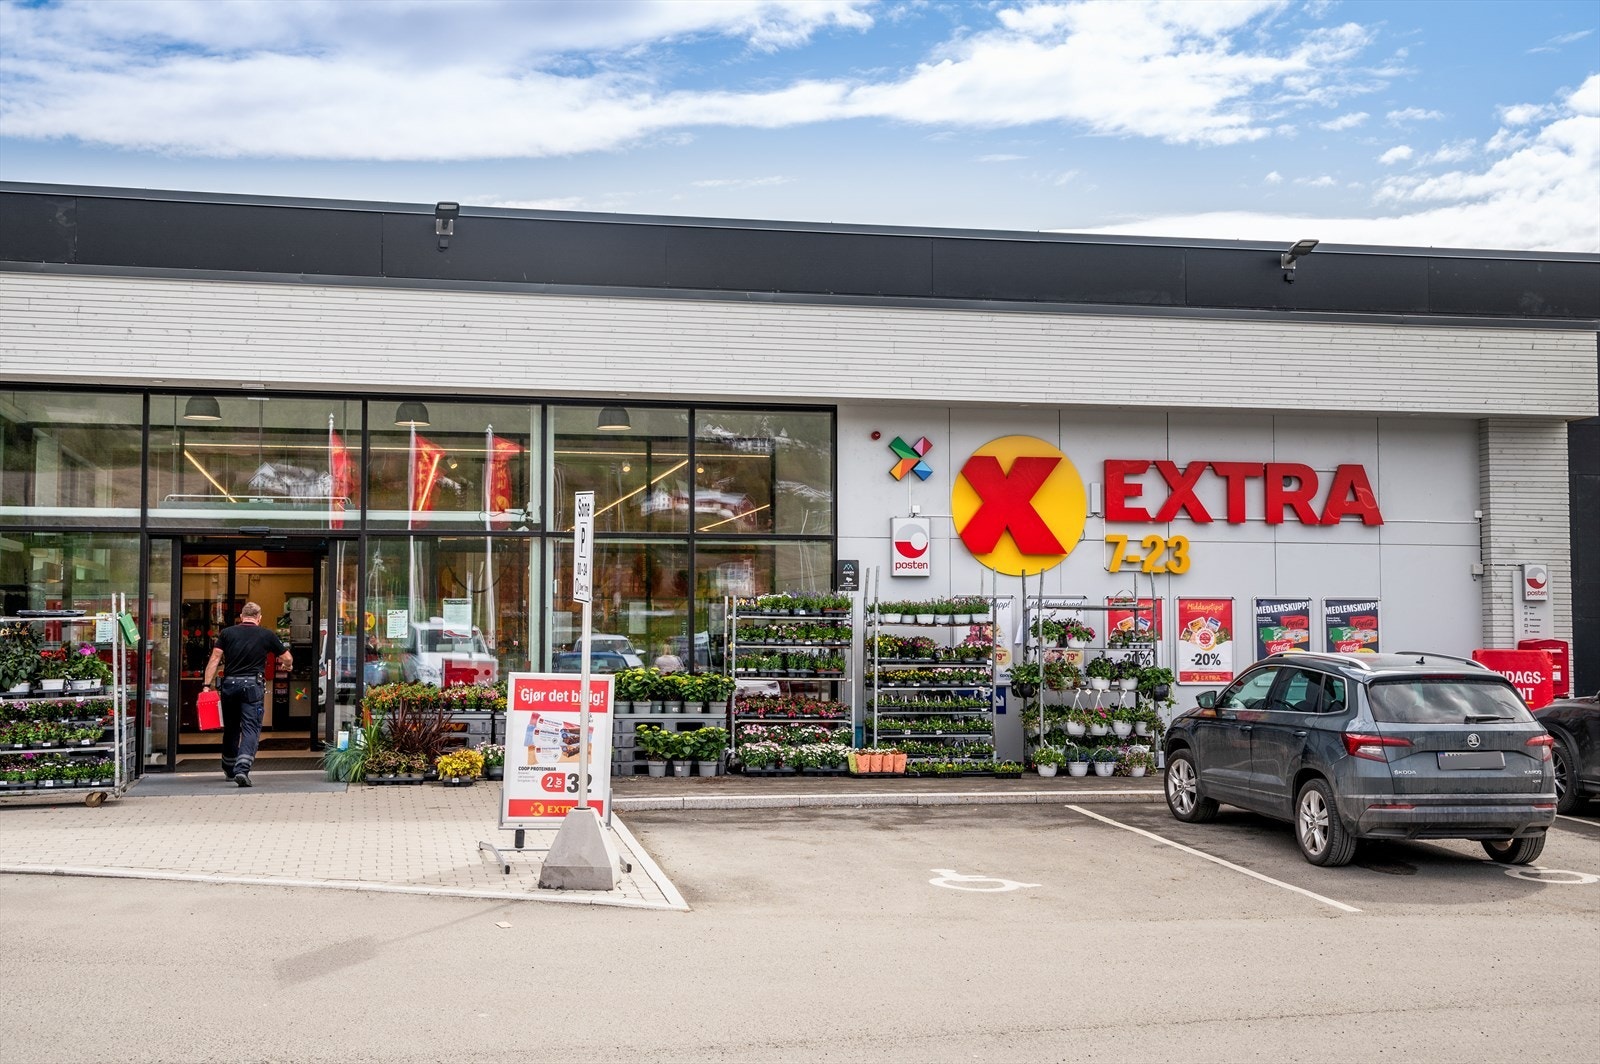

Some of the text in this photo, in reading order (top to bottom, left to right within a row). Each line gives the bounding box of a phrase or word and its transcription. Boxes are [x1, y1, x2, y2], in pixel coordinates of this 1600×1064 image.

[1104, 459, 1384, 526] EXTRA
[581, 527, 586, 553] P
[1105, 534, 1191, 575] 7-23
[895, 560, 929, 571] posten
[1255, 601, 1310, 615] MEDLEMSKUPP!
[1325, 602, 1379, 615] MEDLEMSKUPP!
[1190, 653, 1221, 666] -20%
[1494, 670, 1546, 684] DAGS-
[520, 688, 604, 706] Gjør det biig!
[546, 776, 553, 788] 2
[554, 776, 563, 788] for
